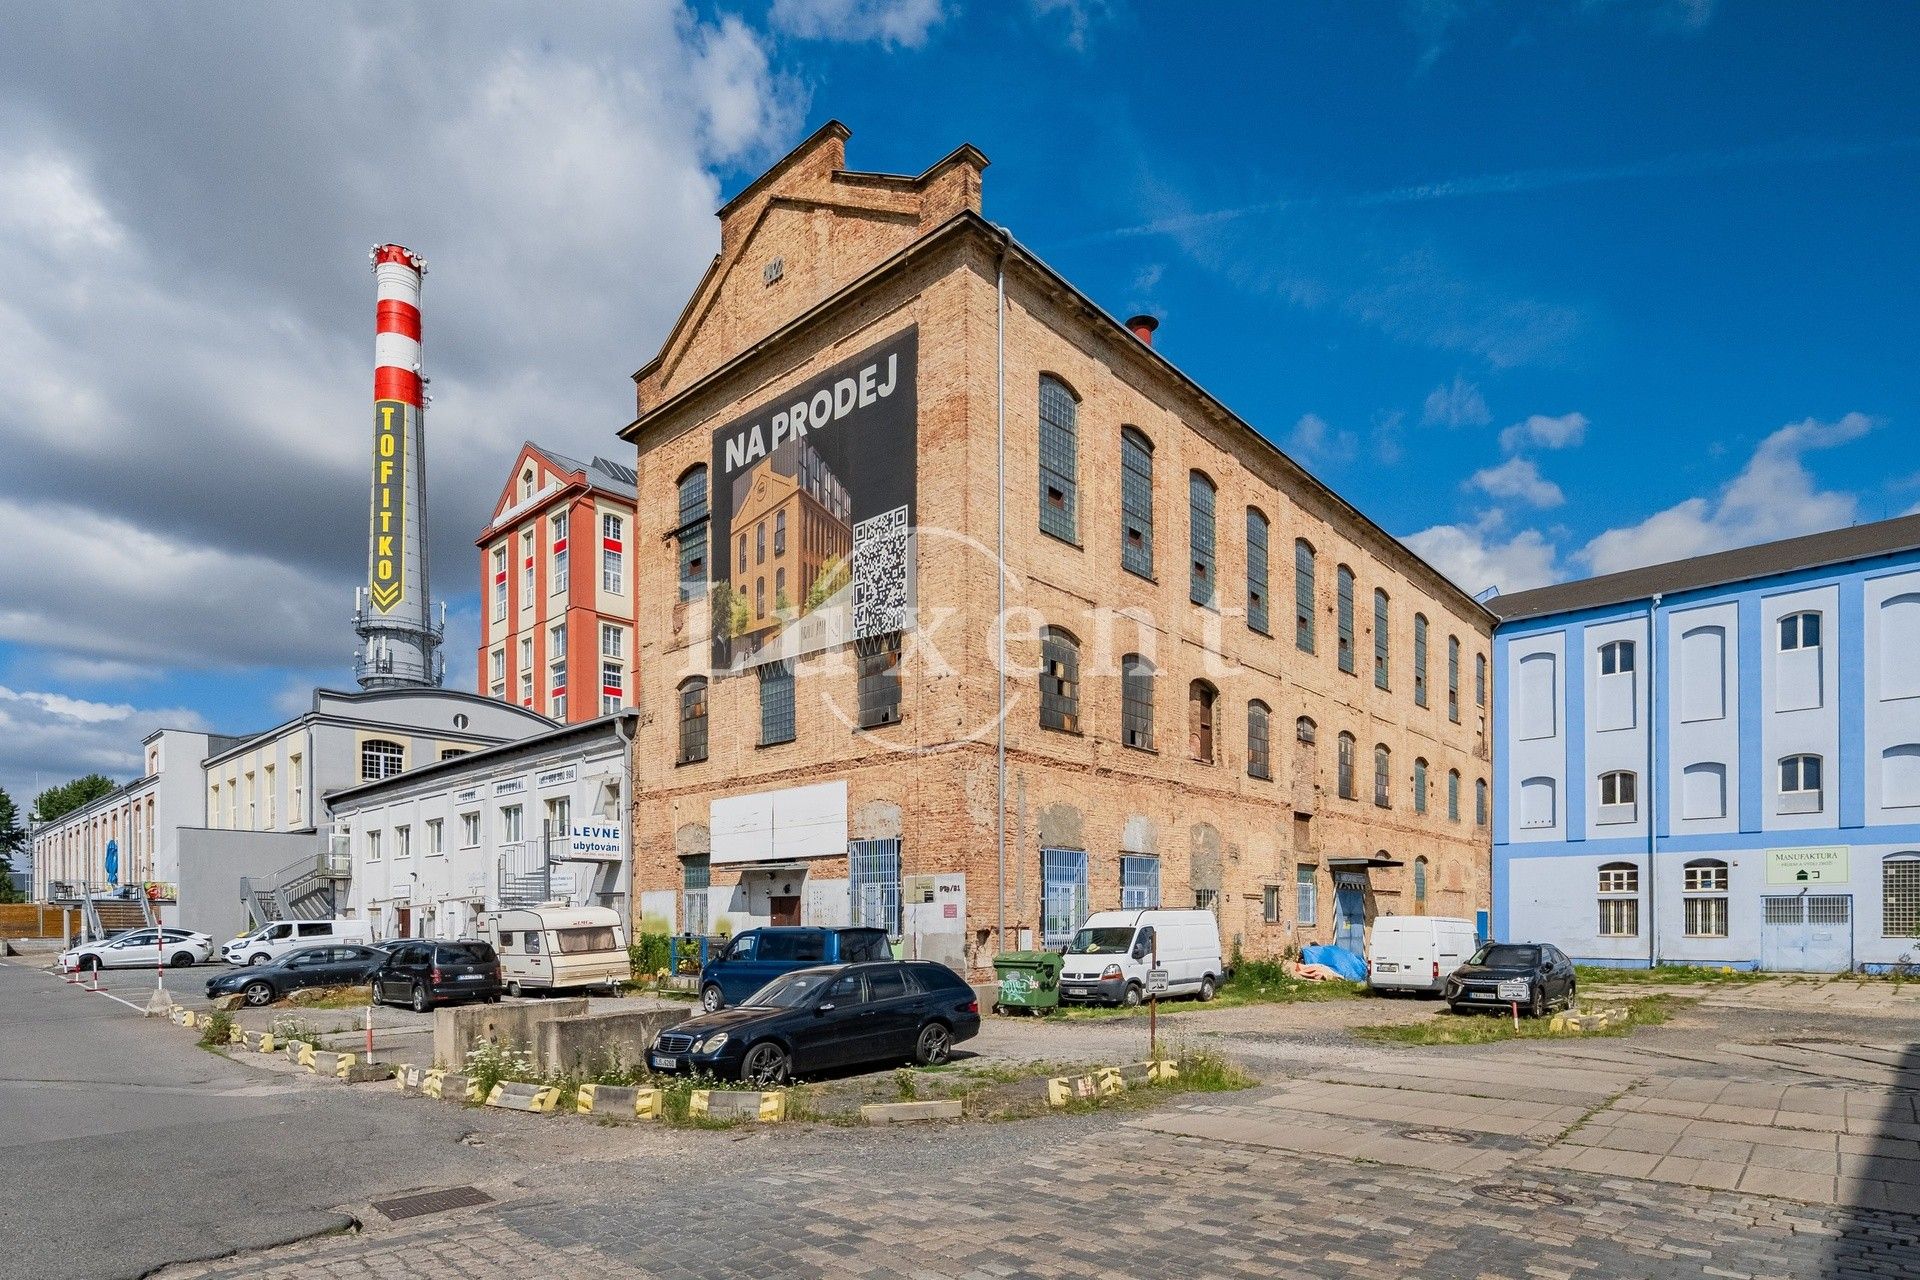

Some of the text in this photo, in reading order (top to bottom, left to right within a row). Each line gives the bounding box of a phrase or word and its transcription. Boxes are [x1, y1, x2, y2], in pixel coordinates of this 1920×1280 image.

[725, 353, 897, 474] NA PRODEJ
[378, 407, 395, 580] TOFITKO
[573, 826, 620, 839] LEVNÉ
[573, 841, 620, 852] ubytování
